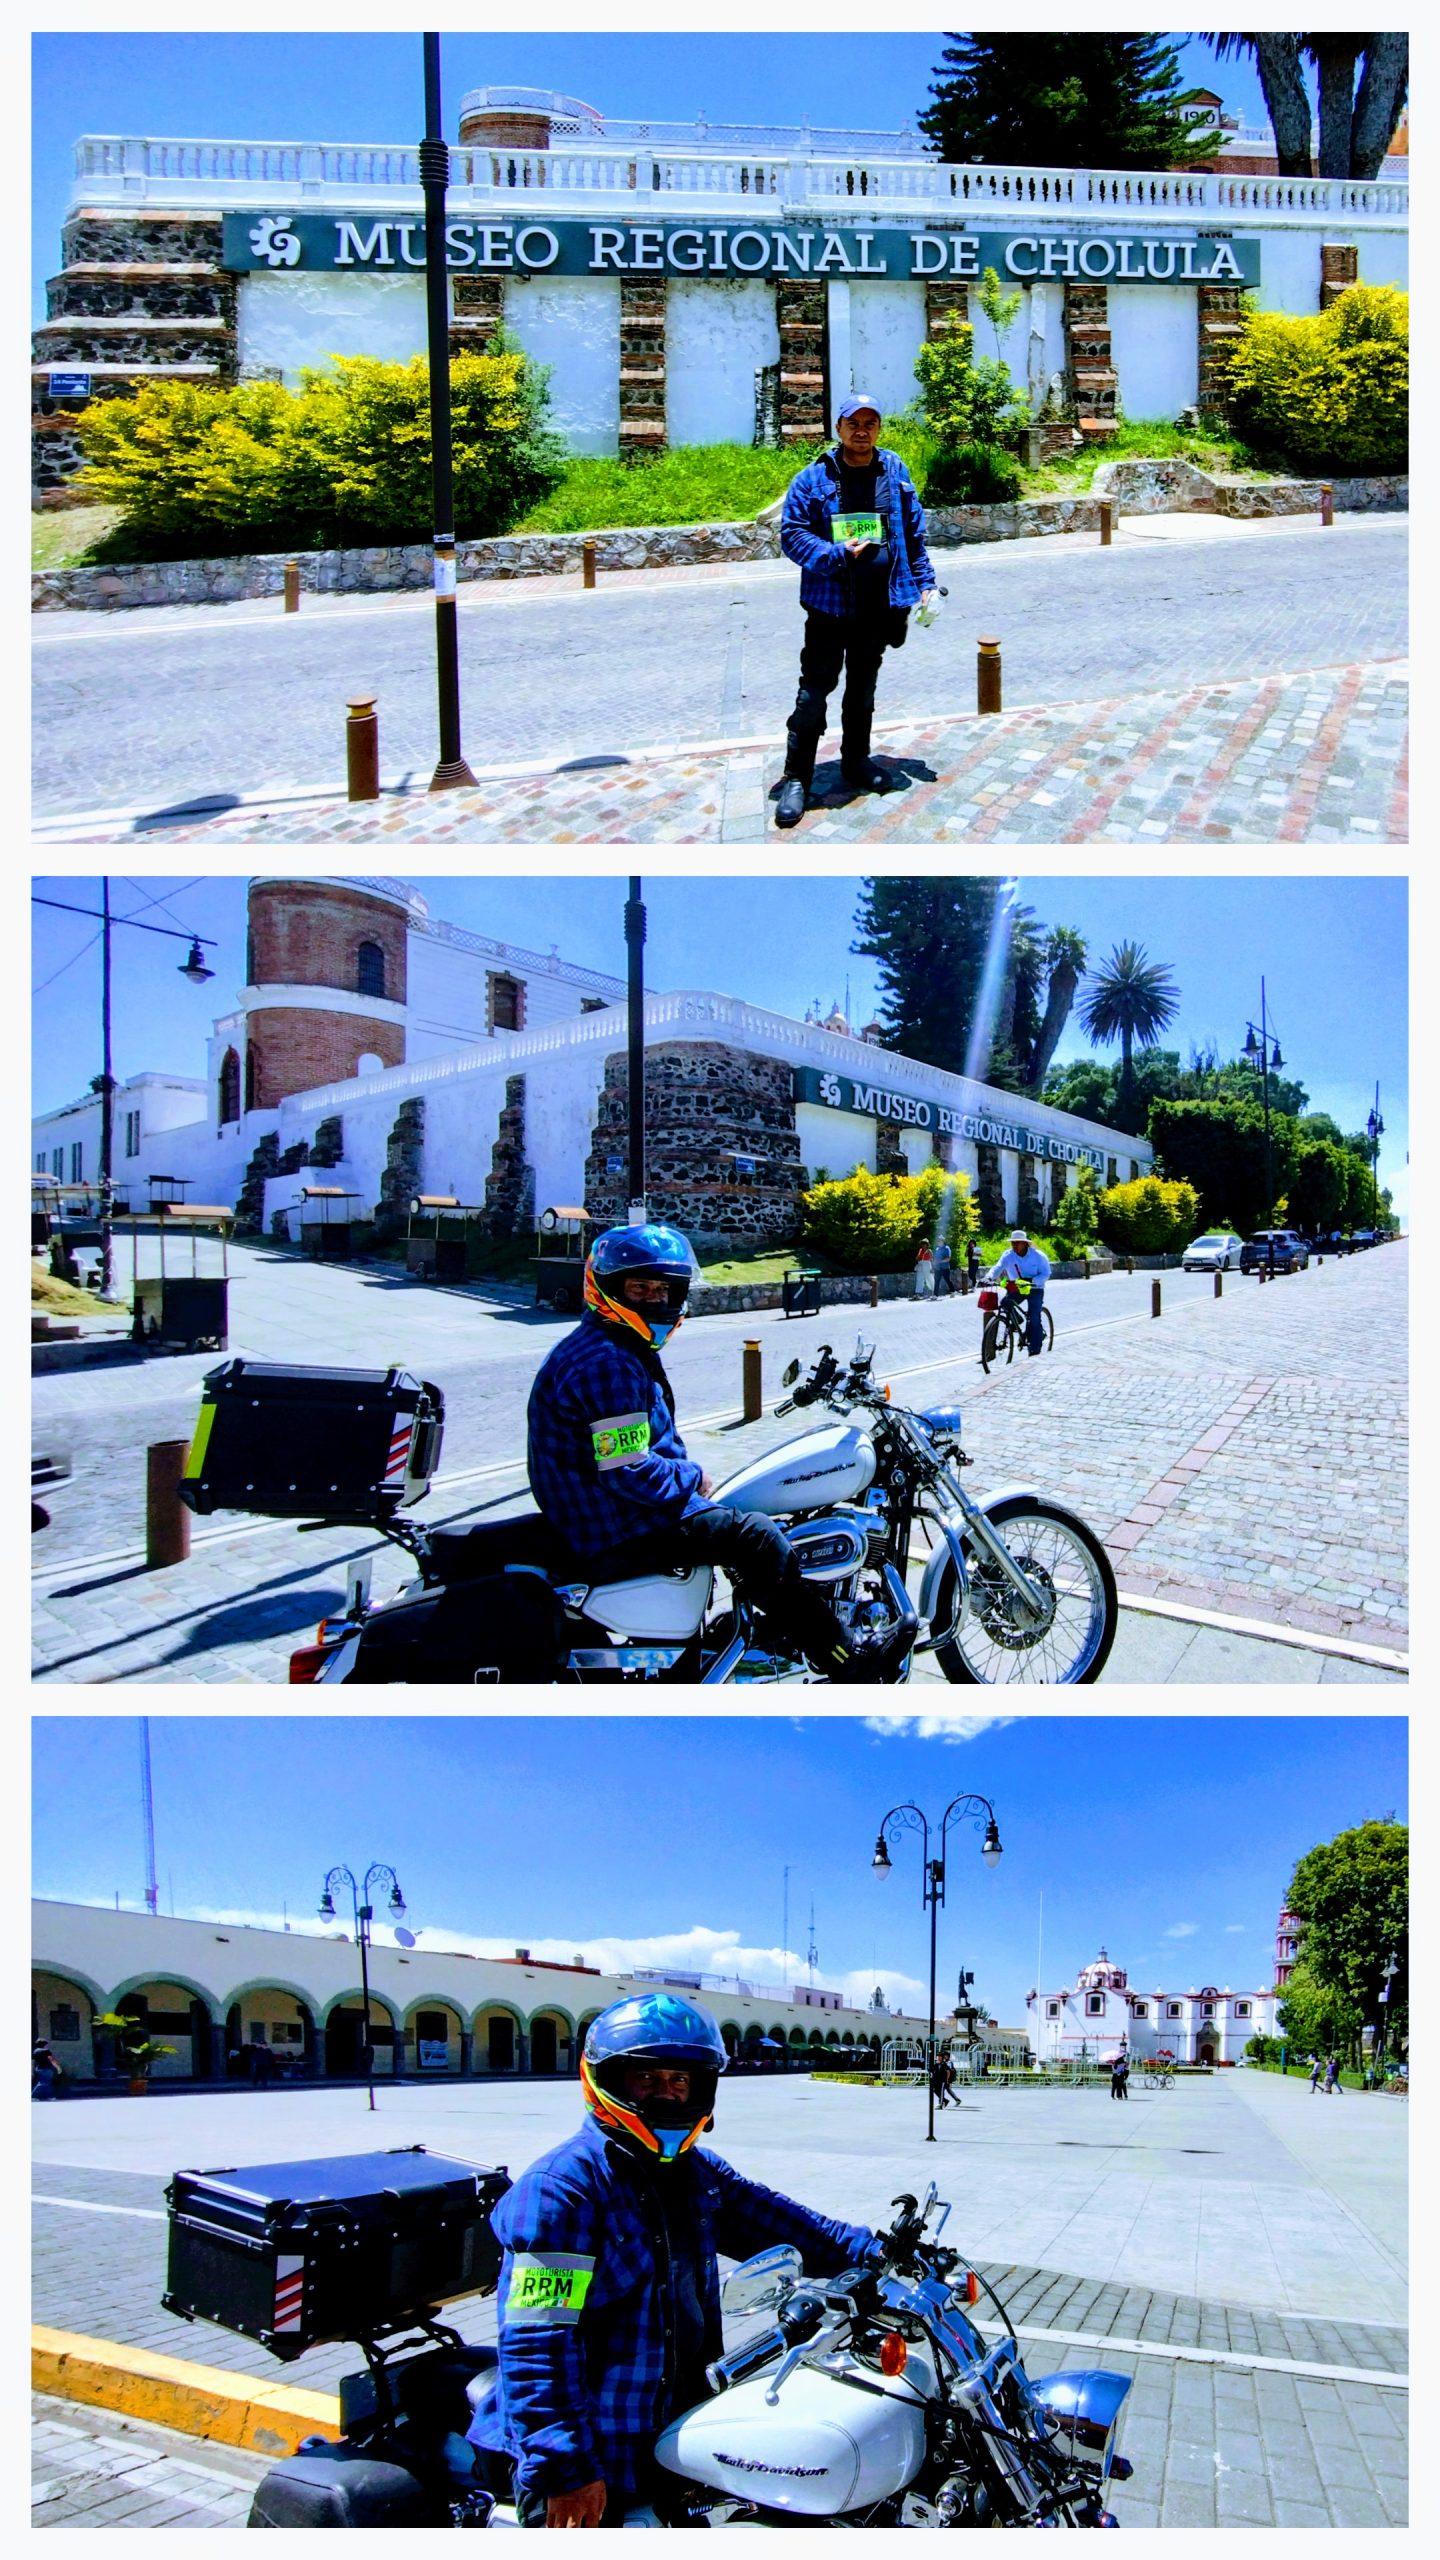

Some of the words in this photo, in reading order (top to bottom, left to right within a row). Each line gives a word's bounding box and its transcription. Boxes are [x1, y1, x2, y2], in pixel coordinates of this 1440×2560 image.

[1185, 110, 1215, 124] 190
[334, 222, 559, 268] MUSEO
[589, 227, 887, 273] REGIONAL
[910, 235, 979, 275] DE
[1005, 238, 1245, 279] CHOLULA
[857, 523, 877, 532] RRM
[852, 1084, 930, 1127] MUSEO
[938, 1108, 1022, 1150] REGIONAL
[1026, 1133, 1044, 1155] DE
[526, 2267, 574, 2277] MOTOTURISTA
[522, 2277, 574, 2297] RRM
